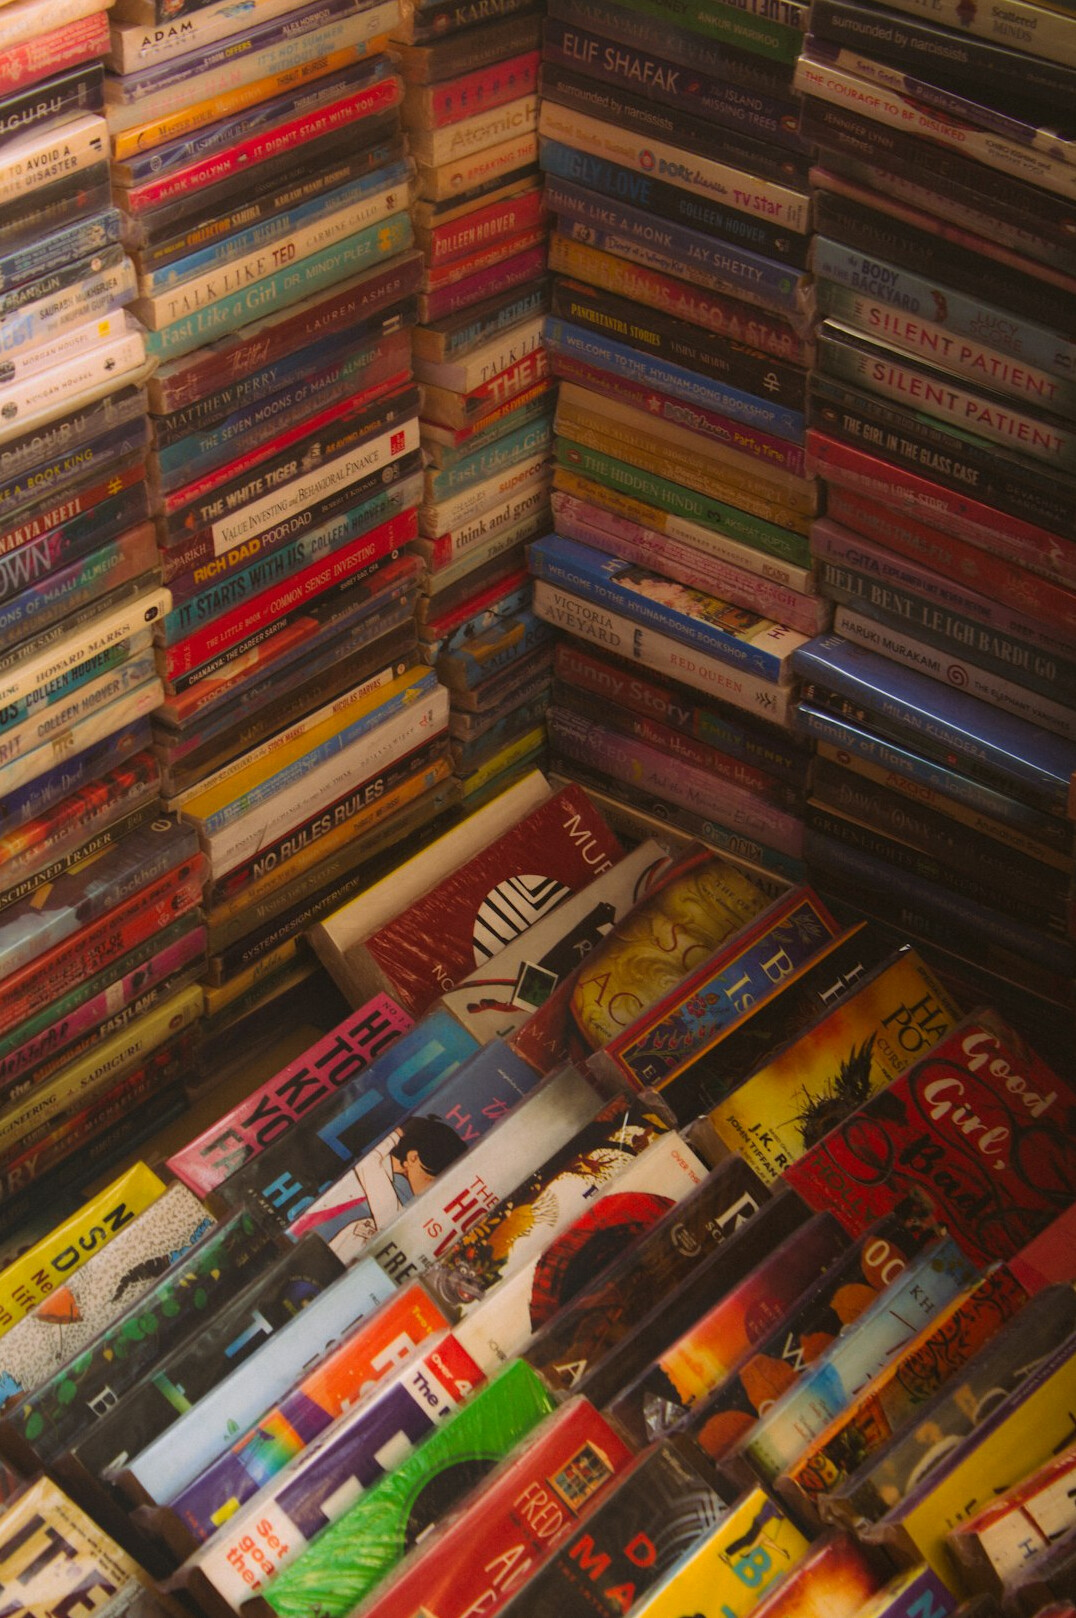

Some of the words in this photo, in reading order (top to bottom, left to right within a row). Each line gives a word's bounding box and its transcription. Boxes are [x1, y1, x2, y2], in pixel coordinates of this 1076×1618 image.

[141, 21, 194, 47] ADAM
[734, 24, 780, 48] WARIKOO
[992, 6, 1038, 29] Scattered
[563, 32, 600, 65] ELIF
[603, 47, 681, 95] SHAFAK
[895, 30, 909, 48] by
[910, 36, 970, 63] narcissists
[556, 81, 609, 107] surrounded
[610, 99, 623, 116] by
[624, 106, 675, 132] narcissists
[749, 111, 777, 132] TREES
[883, 102, 899, 116] TO
[919, 116, 966, 142] DISLIKED
[159, 180, 188, 199] MARK
[193, 160, 231, 184] WOLYNN
[265, 132, 298, 153] DIDN'T
[299, 119, 328, 137] START
[329, 105, 353, 123] WITH
[355, 98, 375, 113] YOU
[450, 112, 523, 152] Atomic
[25, 157, 78, 185] DISASTER
[27, 150, 60, 170] AVOID
[63, 146, 71, 156] A
[435, 230, 475, 257] COLLEEN
[477, 212, 516, 240] HOOVER
[547, 189, 585, 213] THINK
[589, 205, 617, 224] LIKE
[619, 214, 629, 227] A
[632, 225, 673, 248] MONK
[688, 244, 710, 265] JAY
[713, 254, 765, 282] SHETTY
[725, 215, 766, 240] HOOVER
[168, 283, 218, 318] TALK
[224, 258, 267, 291] LIKE
[272, 243, 296, 268] TED
[851, 272, 920, 313] BACKYARD
[861, 259, 899, 287] BODY
[160, 321, 194, 347] Fast
[197, 305, 230, 328] Like
[245, 281, 277, 310] Girl
[305, 258, 341, 281] MINDY
[305, 302, 357, 334] LAUREN
[361, 279, 402, 305] ASHER
[869, 308, 955, 357] SILENT
[960, 345, 1061, 401] PATIENT
[165, 390, 233, 430] MATTHEW
[235, 368, 279, 398] PERRY
[200, 436, 220, 453] THE
[222, 418, 252, 440] SEVEN
[255, 396, 292, 423] MOONS
[295, 389, 308, 403] OF
[310, 370, 340, 394] MAALI
[342, 347, 383, 379] ALMEIDA
[488, 359, 534, 400] THE
[566, 336, 612, 360] WELCOME
[615, 353, 628, 365] TO
[628, 358, 647, 372] THE
[649, 368, 722, 402] HYUNAM-DONG
[722, 394, 776, 421] BOOKSHOP
[872, 363, 960, 411] SILENT
[965, 402, 1067, 454] PATIENT
[733, 433, 762, 455] Party
[842, 414, 861, 434] THE
[862, 423, 884, 446] GIRL
[886, 436, 898, 450] IN
[899, 440, 919, 460] THE
[919, 448, 951, 477] GLASS
[952, 461, 981, 487] CASE
[27, 463, 62, 488] BOOK
[63, 449, 94, 471] KING
[201, 502, 225, 520] THE
[226, 480, 264, 508] WHITE
[265, 461, 298, 486] TIGER
[448, 462, 476, 487] Fast
[582, 454, 609, 475] THE
[610, 465, 659, 497] HIDDEN
[662, 489, 704, 515] HINDU
[42, 498, 82, 530] NEETI
[222, 518, 248, 543] VALUE
[248, 499, 288, 531] INVESTING
[298, 468, 344, 502] BEHAVIORAL
[345, 449, 380, 477] FINANCE
[455, 521, 488, 549] think
[489, 507, 511, 530] and
[513, 490, 542, 520] grow
[193, 559, 227, 585] RICH
[228, 539, 261, 569] DAD
[290, 511, 313, 533] DAD
[846, 549, 881, 575] GITA
[26, 600, 41, 614] OF
[44, 579, 77, 605] MAALI
[80, 553, 126, 585] ALMEIDA
[177, 605, 193, 630] IT
[197, 576, 245, 618] STARTS
[247, 558, 284, 594] WITH
[288, 543, 305, 569] US
[310, 521, 350, 555] COLLEEN
[220, 621, 244, 643] LITTLE
[269, 585, 304, 614] COMMON
[305, 570, 332, 593] SENSE
[333, 542, 377, 578] INVESTING
[545, 606, 621, 648] AVEYARD
[548, 565, 592, 590] WELCOME
[594, 585, 607, 597] TO
[607, 591, 625, 606] THE
[627, 602, 696, 639] HYUNAM-DONG
[697, 630, 748, 660] BOOKSHOP
[553, 594, 614, 630] VICTORIA
[870, 586, 914, 619] BENT
[921, 607, 975, 647] LEIGH
[977, 632, 1057, 682] BARDUGO
[35, 649, 85, 683] HOWARD
[840, 619, 881, 645] HARUKI
[882, 638, 941, 673] MURAKAMI
[25, 675, 69, 708] COLLEEN
[71, 648, 111, 683] HOOVER
[557, 648, 624, 694] Funny
[629, 681, 691, 726] Story
[669, 653, 696, 672] RED
[698, 664, 743, 693] QUEEN
[37, 703, 80, 737] COLLEEN
[82, 680, 120, 709] HOOVER
[882, 702, 923, 730] MILAN
[925, 723, 989, 761] KUNDERA
[860, 740, 876, 752] of
[886, 772, 937, 803] Azadi
[64, 833, 112, 867] TRADER
[252, 853, 277, 880] NO
[280, 815, 331, 862] RULES
[334, 779, 385, 825] RULES
[115, 857, 170, 899] lockhart
[242, 932, 278, 960] SYSTEM
[277, 910, 312, 939] DESIGN
[311, 876, 361, 915] INTERVIEW
[100, 988, 158, 1037] FASTLANE
[80, 1041, 143, 1088] SADHGURU
[961, 1032, 1059, 1119] Good
[726, 1115, 752, 1144] JOHN
[748, 1123, 772, 1153] J.K.
[470, 1175, 500, 1210] THE
[422, 1218, 443, 1239] IS
[413, 1371, 439, 1407] The
[256, 1518, 290, 1559] set
